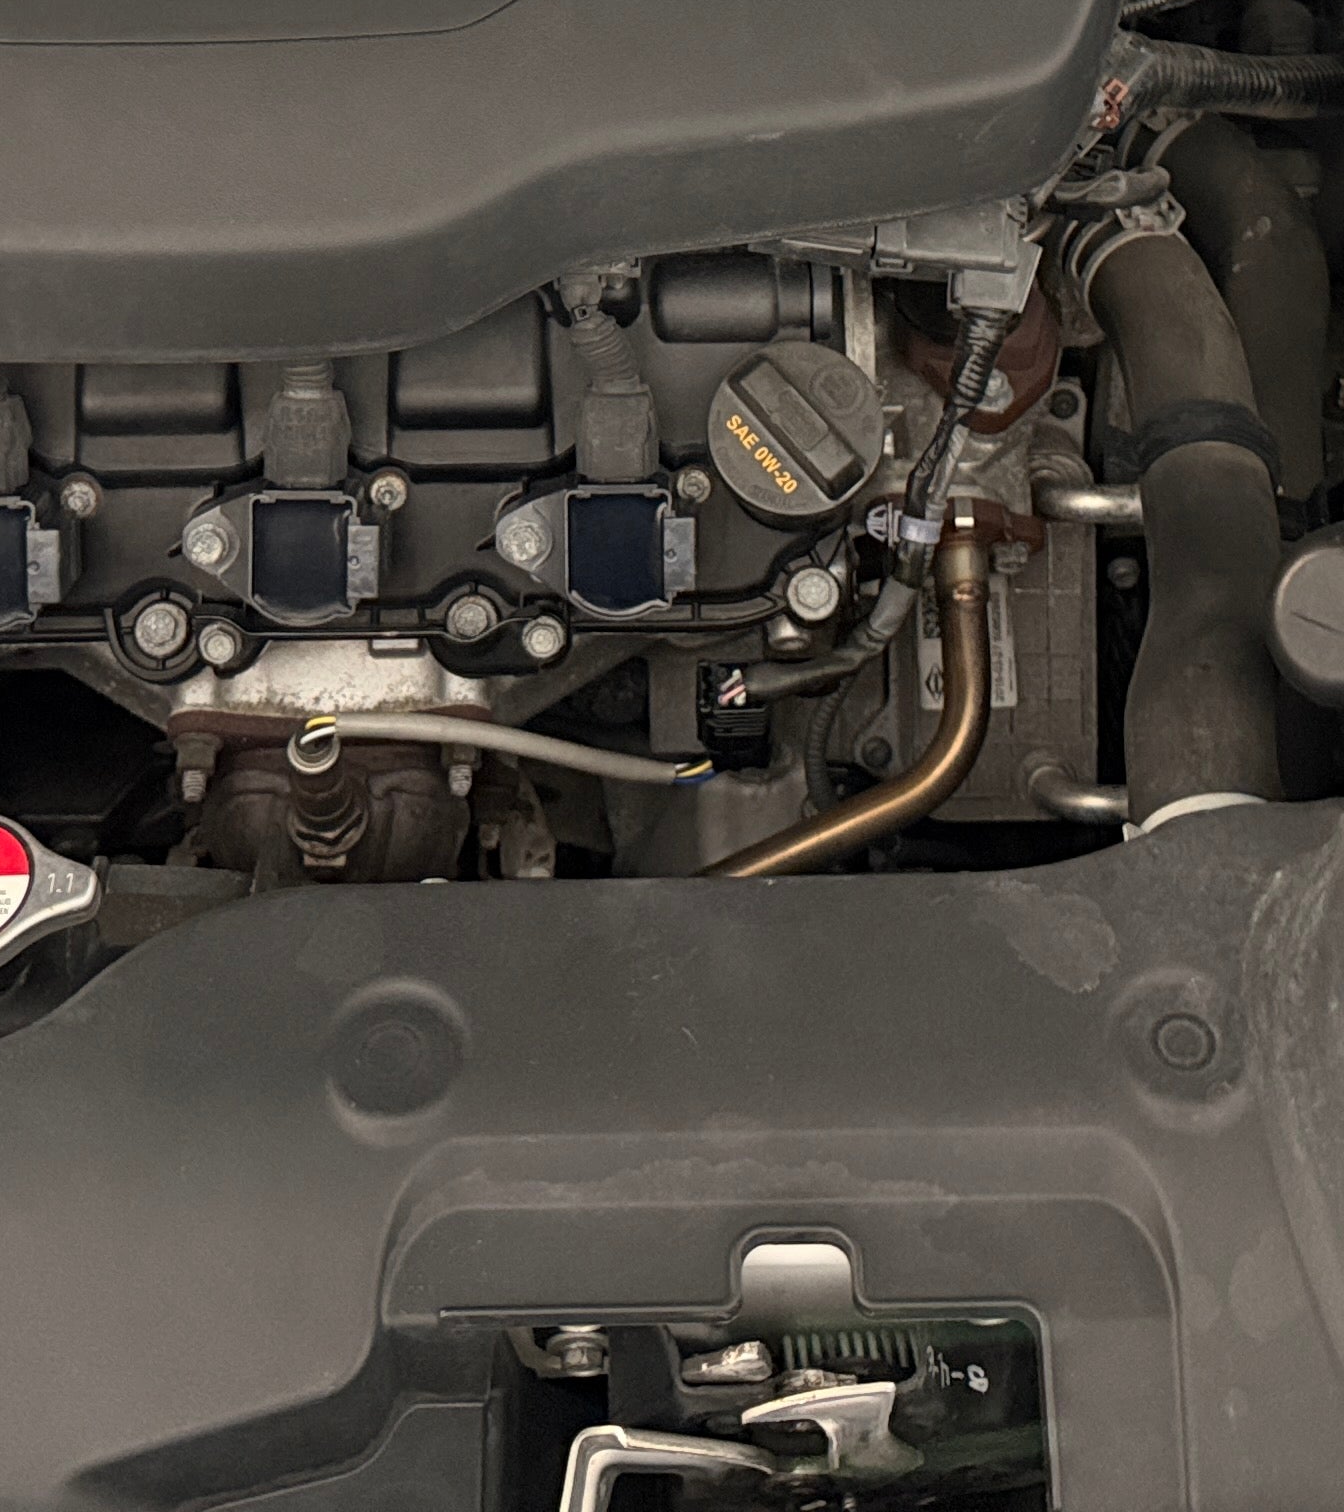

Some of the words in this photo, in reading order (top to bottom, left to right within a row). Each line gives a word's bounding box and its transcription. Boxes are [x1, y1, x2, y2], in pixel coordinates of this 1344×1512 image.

[726, 414, 761, 450] SAE
[754, 446, 798, 494] 0W-20
[47, 872, 74, 894] 1.1
